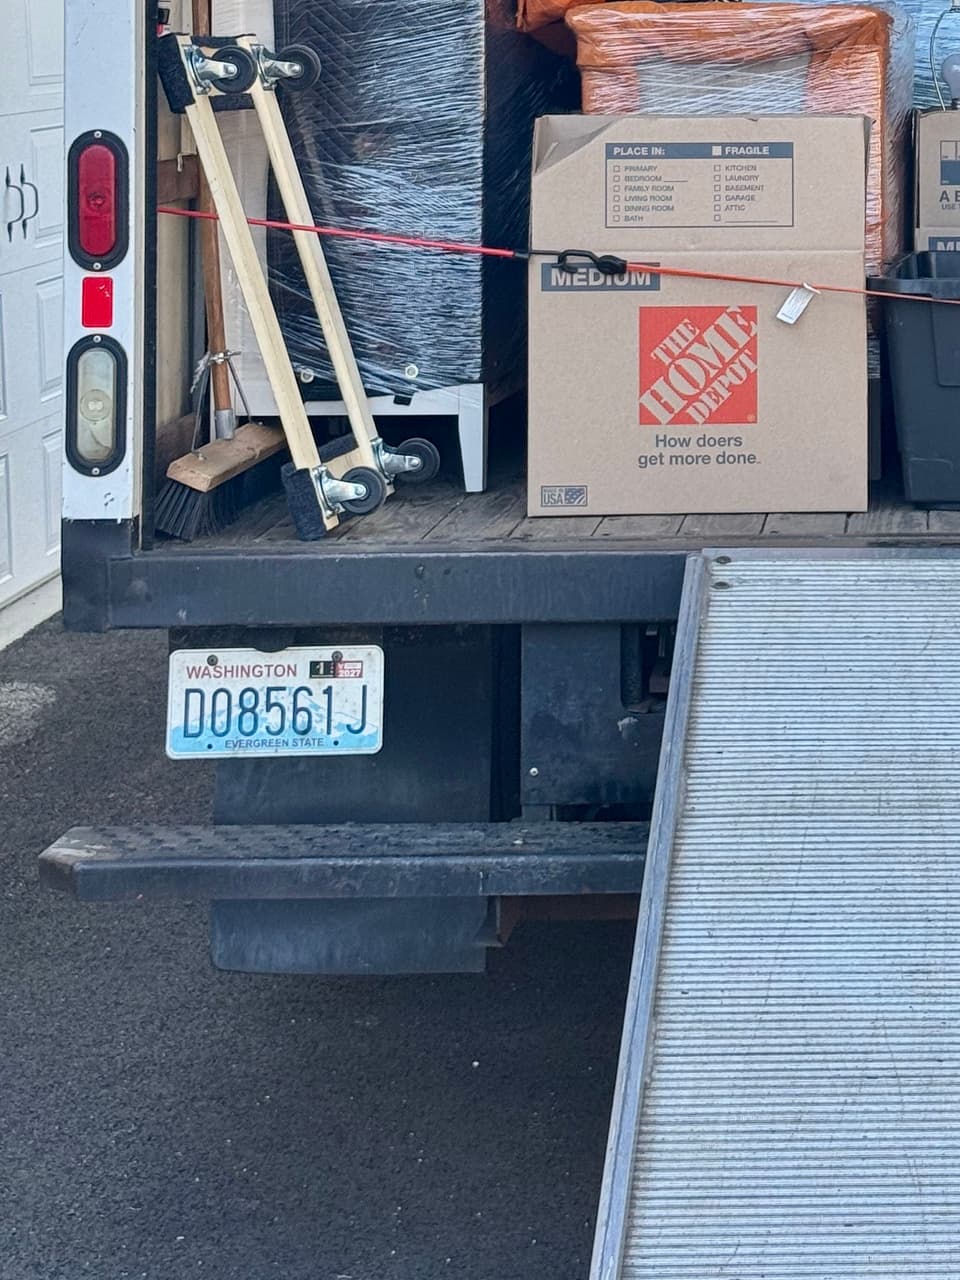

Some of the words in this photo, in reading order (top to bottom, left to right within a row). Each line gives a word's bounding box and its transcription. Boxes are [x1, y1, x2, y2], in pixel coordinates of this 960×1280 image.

[613, 146, 648, 156] PLACE
[651, 146, 665, 156] IN:
[725, 145, 770, 156] FRAGILE
[939, 190, 950, 202] A
[651, 319, 700, 367] THE
[639, 306, 757, 425] HOME
[685, 349, 757, 425] DEPOT
[655, 433, 692, 449] How
[696, 433, 743, 449] doers
[638, 453, 665, 469] get
[669, 453, 711, 466] more
[544, 493, 563, 504] USA
[186, 663, 297, 679] WASHINGTON
[183, 685, 368, 738] D08561J
[225, 738, 289, 749] EVERGREEN
[291, 737, 325, 748] STATE
